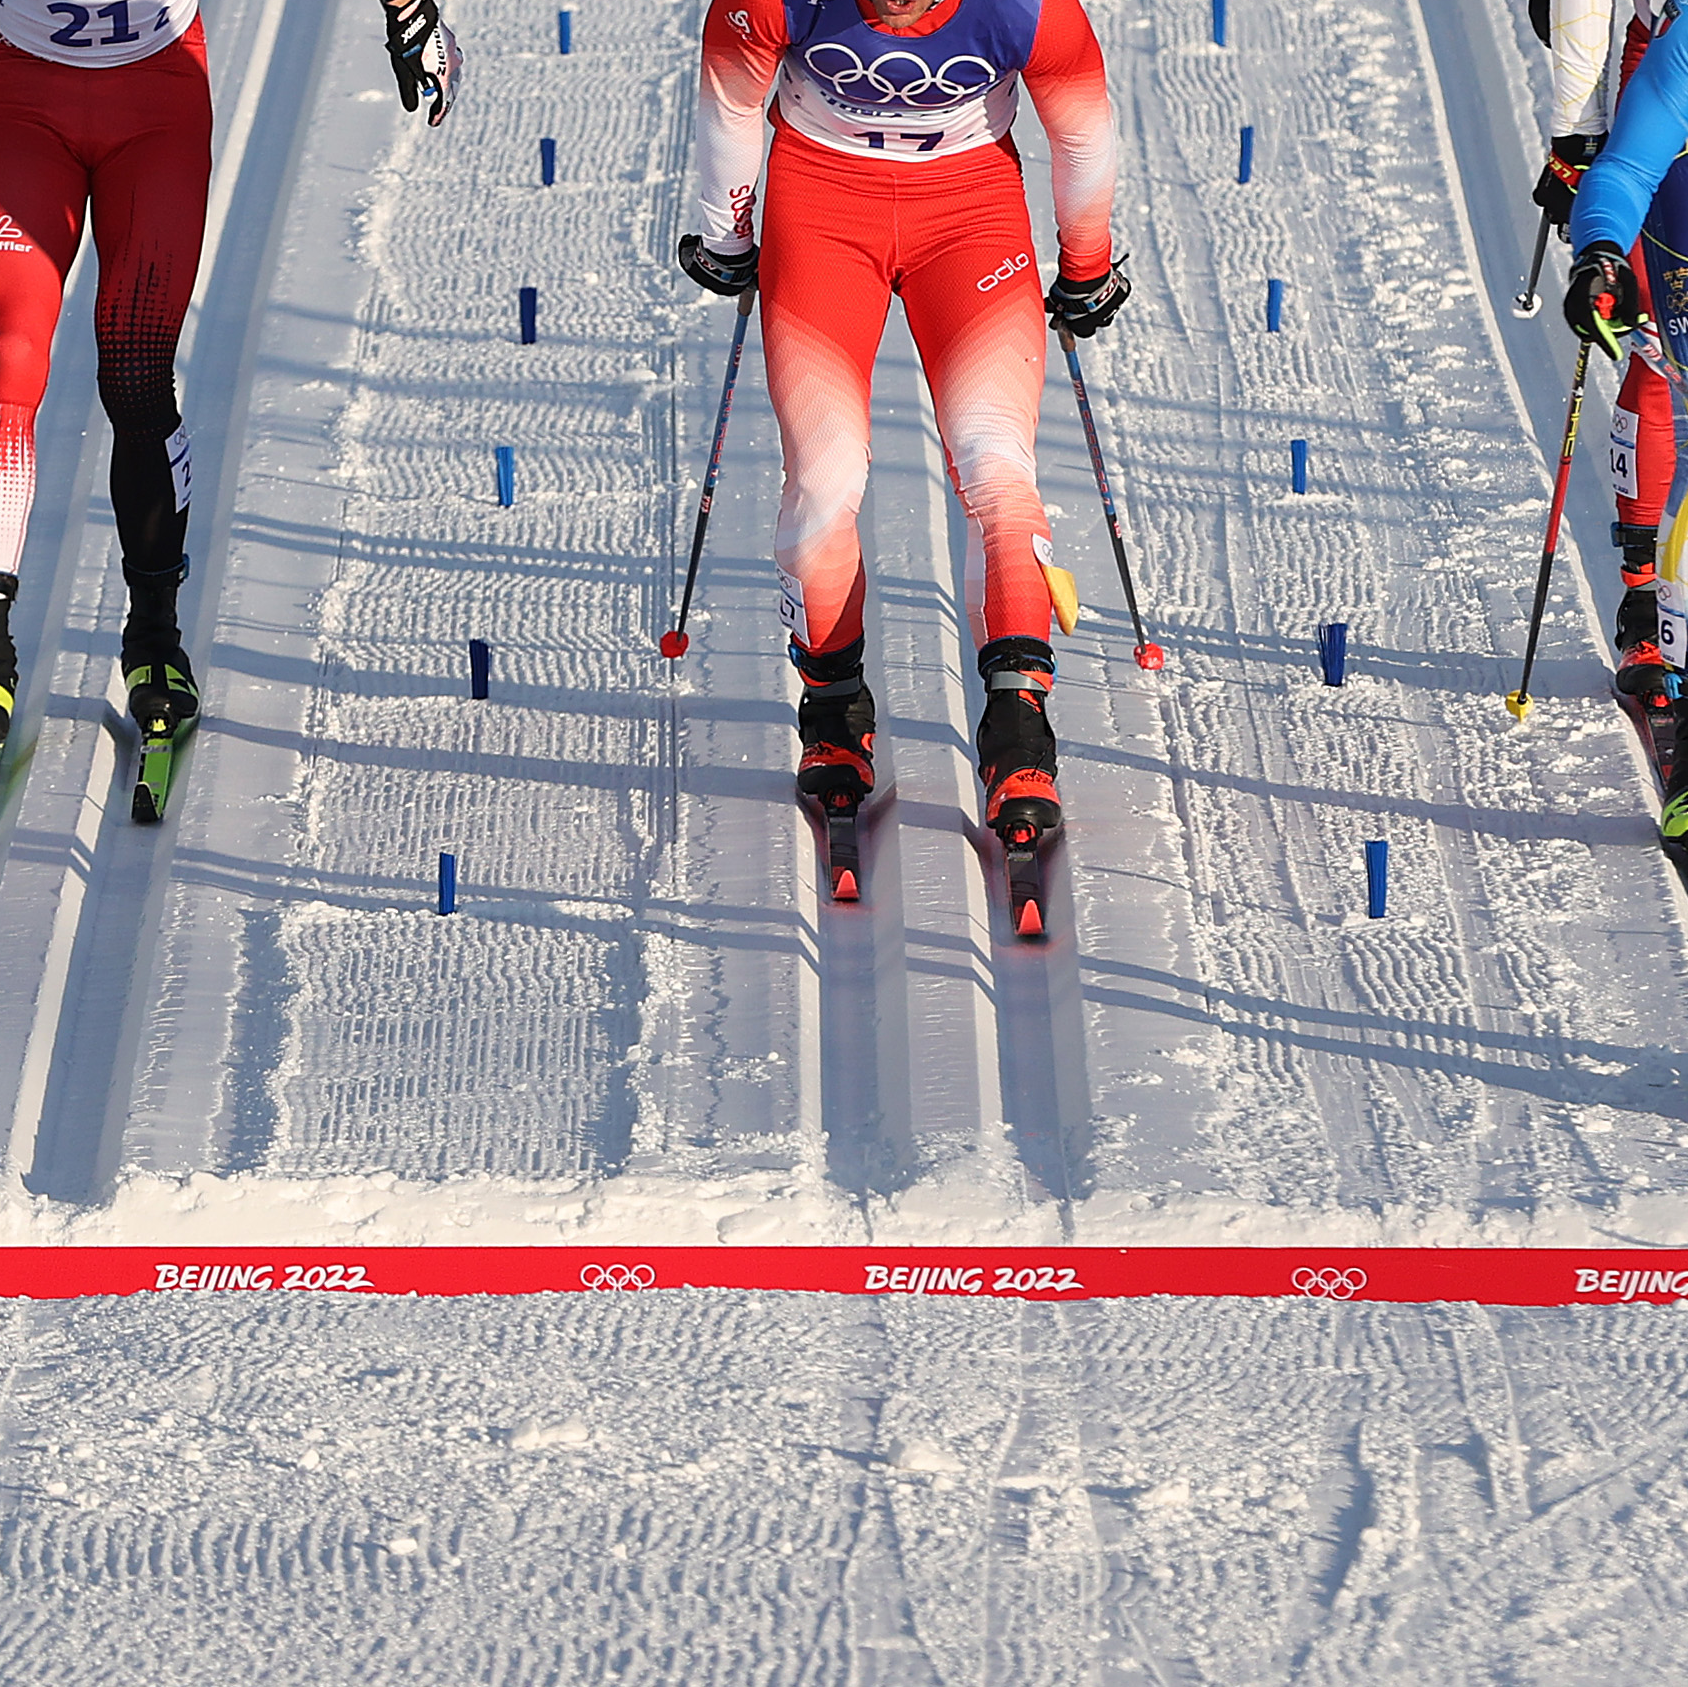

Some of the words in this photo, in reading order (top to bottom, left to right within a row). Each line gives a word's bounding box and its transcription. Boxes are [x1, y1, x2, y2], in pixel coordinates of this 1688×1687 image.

[47, 0, 140, 48] 21
[976, 252, 1030, 292] odlo
[154, 1264, 274, 1292] BEIJING
[282, 1264, 375, 1290] 2022
[864, 1265, 985, 1294] BEIJING
[992, 1267, 1086, 1292] 2022
